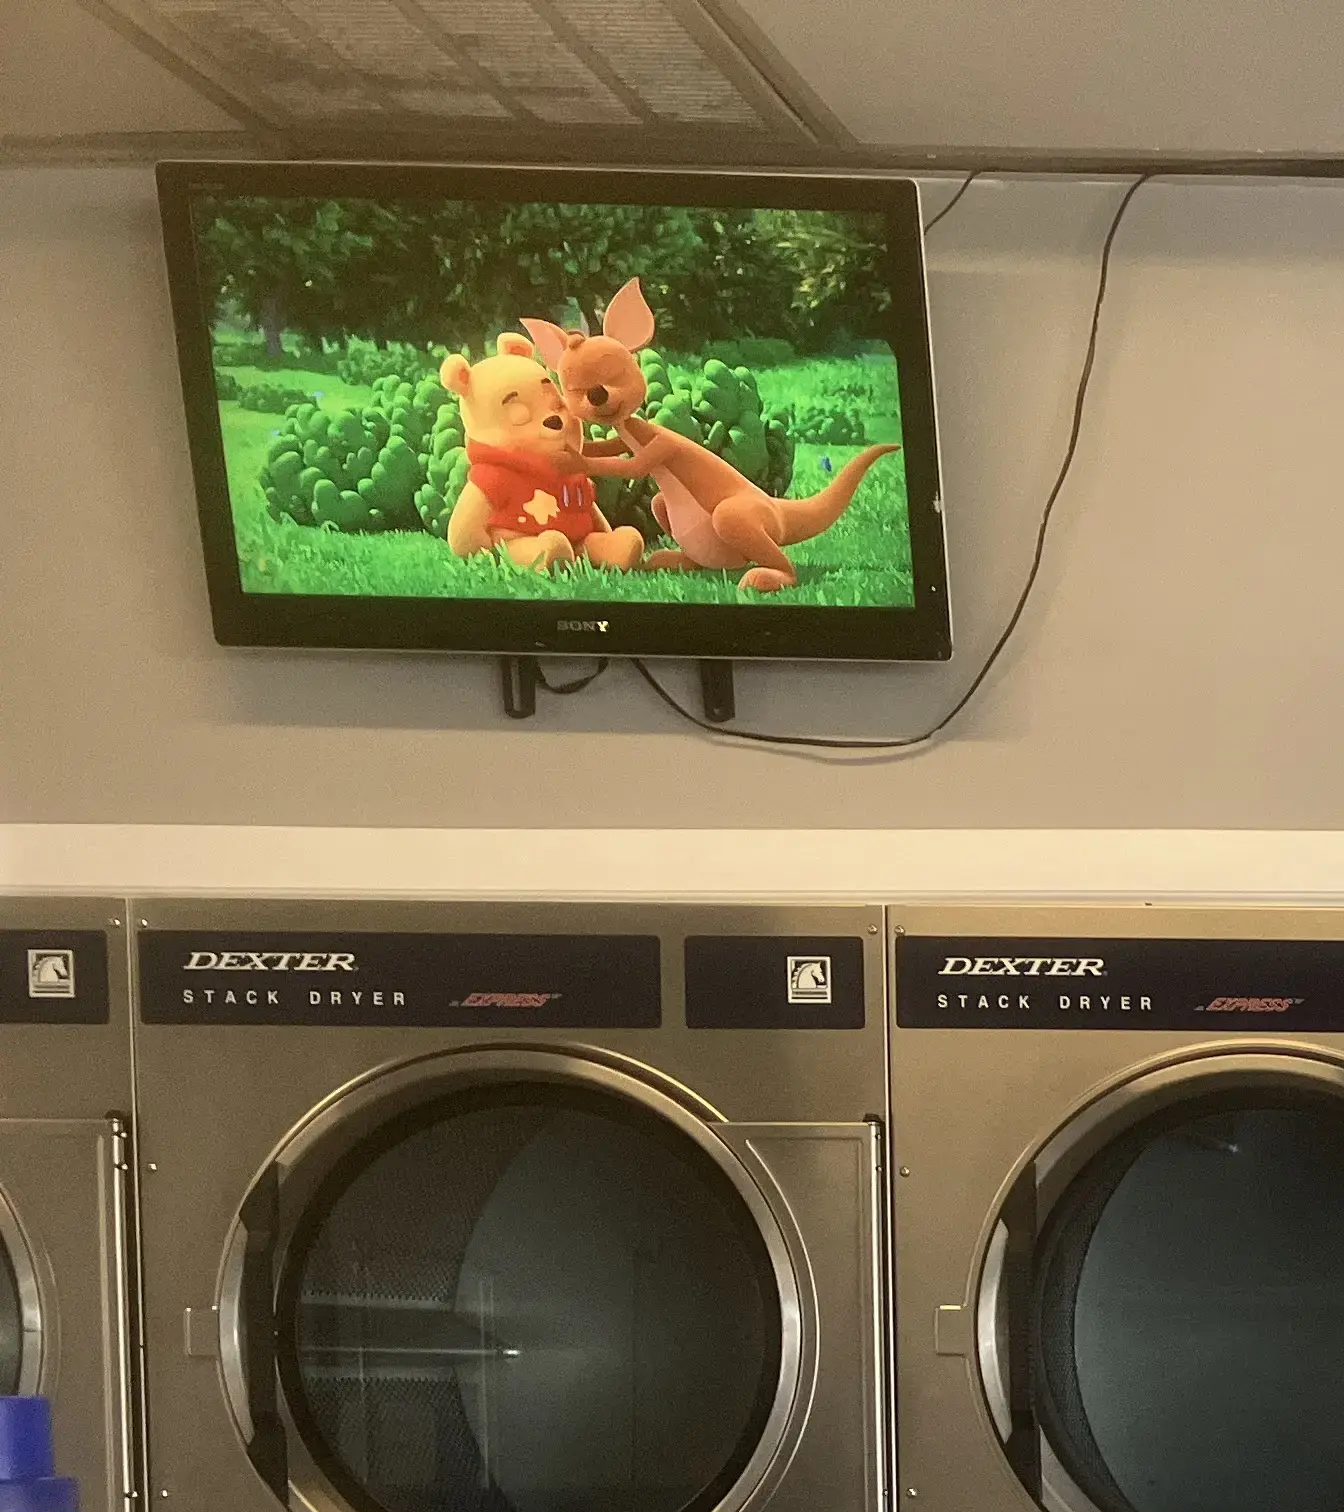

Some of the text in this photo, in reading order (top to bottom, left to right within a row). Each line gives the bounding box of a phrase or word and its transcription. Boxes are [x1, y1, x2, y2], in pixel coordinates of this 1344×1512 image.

[557, 620, 609, 632] SONY
[182, 952, 355, 971] DEXTER
[937, 957, 1105, 976] DEXTER
[183, 989, 405, 1006] STACK DRYER
[937, 994, 1152, 1010] STACK DRYER
